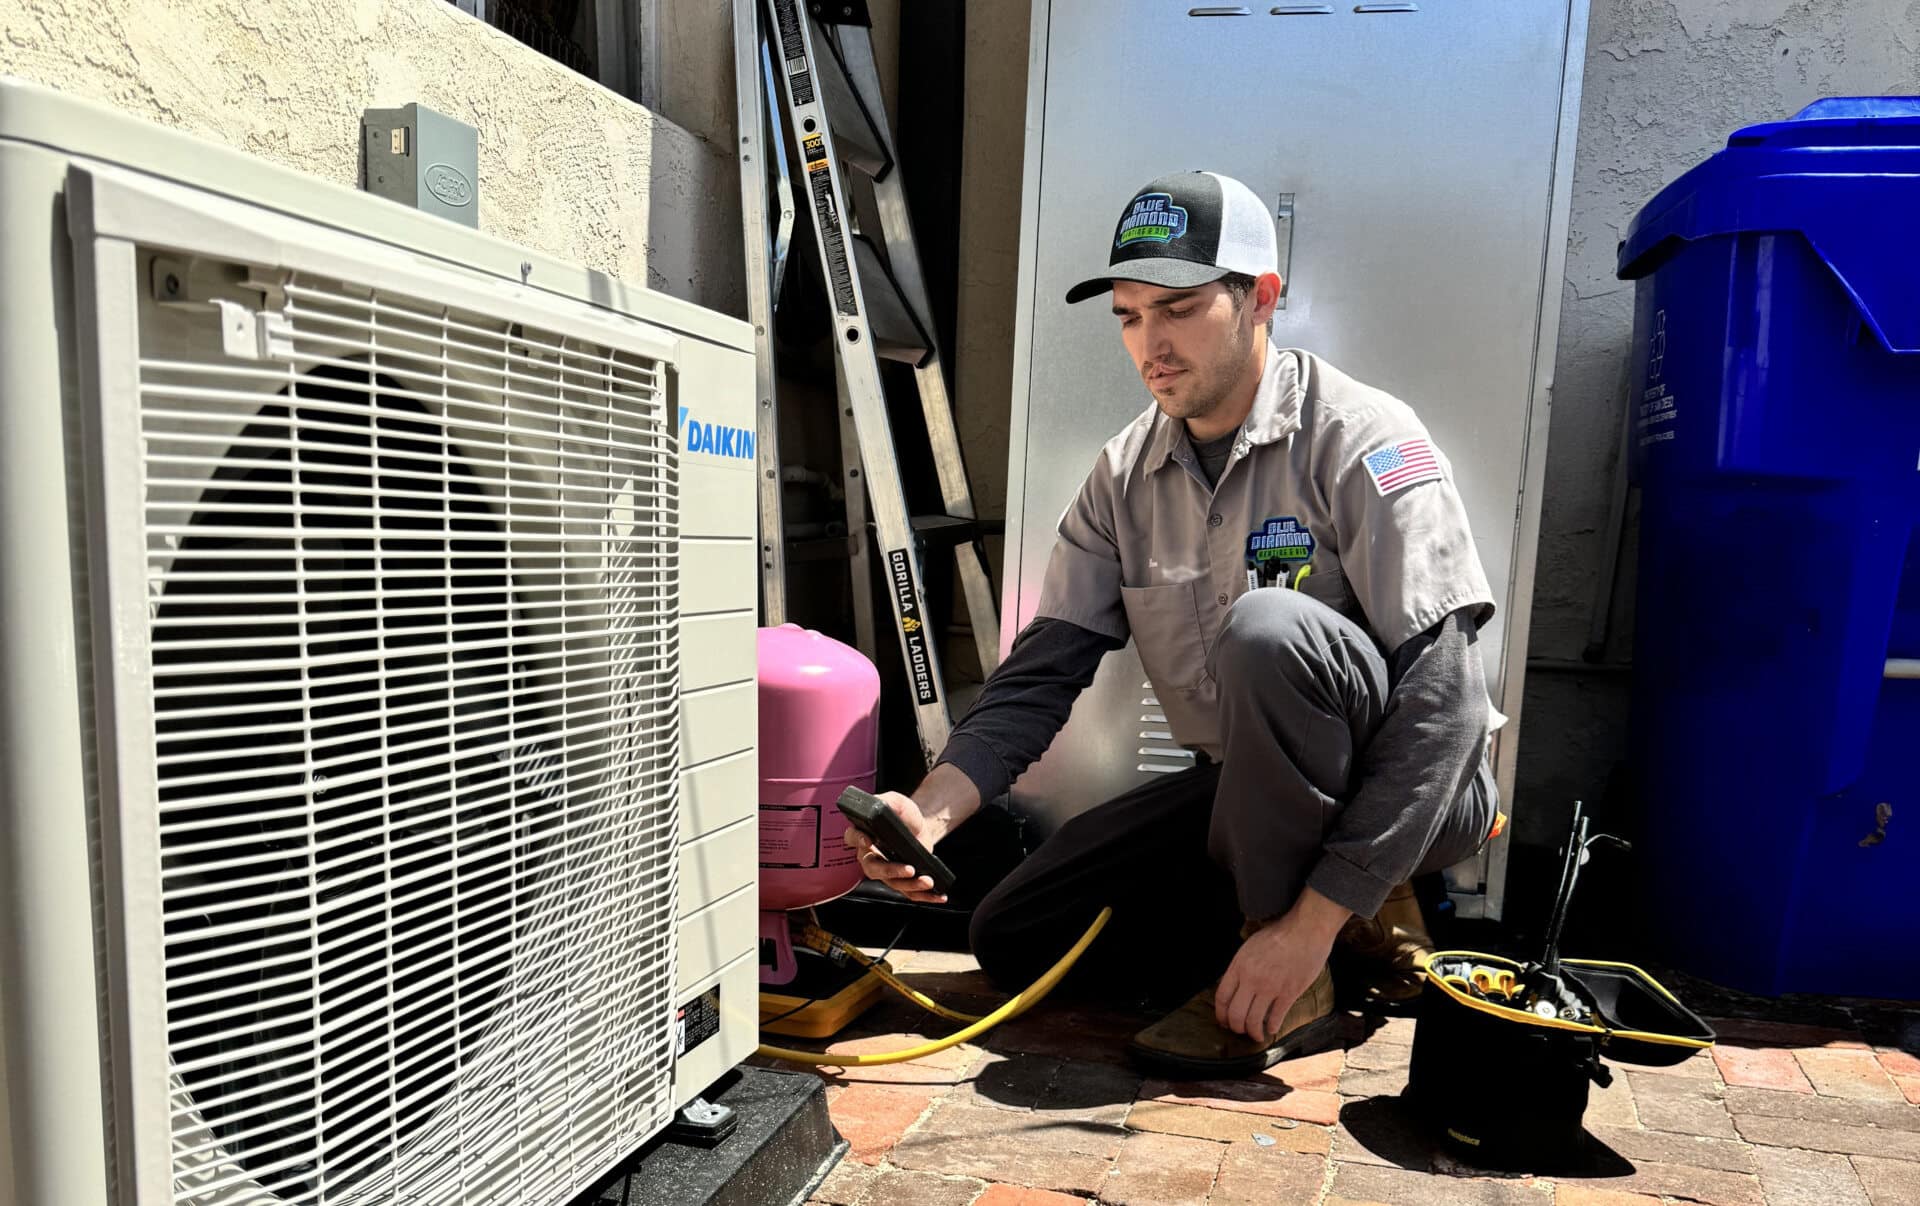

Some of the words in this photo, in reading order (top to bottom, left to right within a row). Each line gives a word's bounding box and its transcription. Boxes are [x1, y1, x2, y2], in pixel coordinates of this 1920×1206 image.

[1134, 200, 1165, 214] BLUE
[1121, 212, 1178, 233] DIAMOND
[688, 420, 755, 459] DAIKIN
[1268, 521, 1296, 534] BLUE
[1251, 533, 1311, 549] DIAMOND
[892, 552, 913, 612] GORILLA
[909, 636, 931, 699] LADDERS
